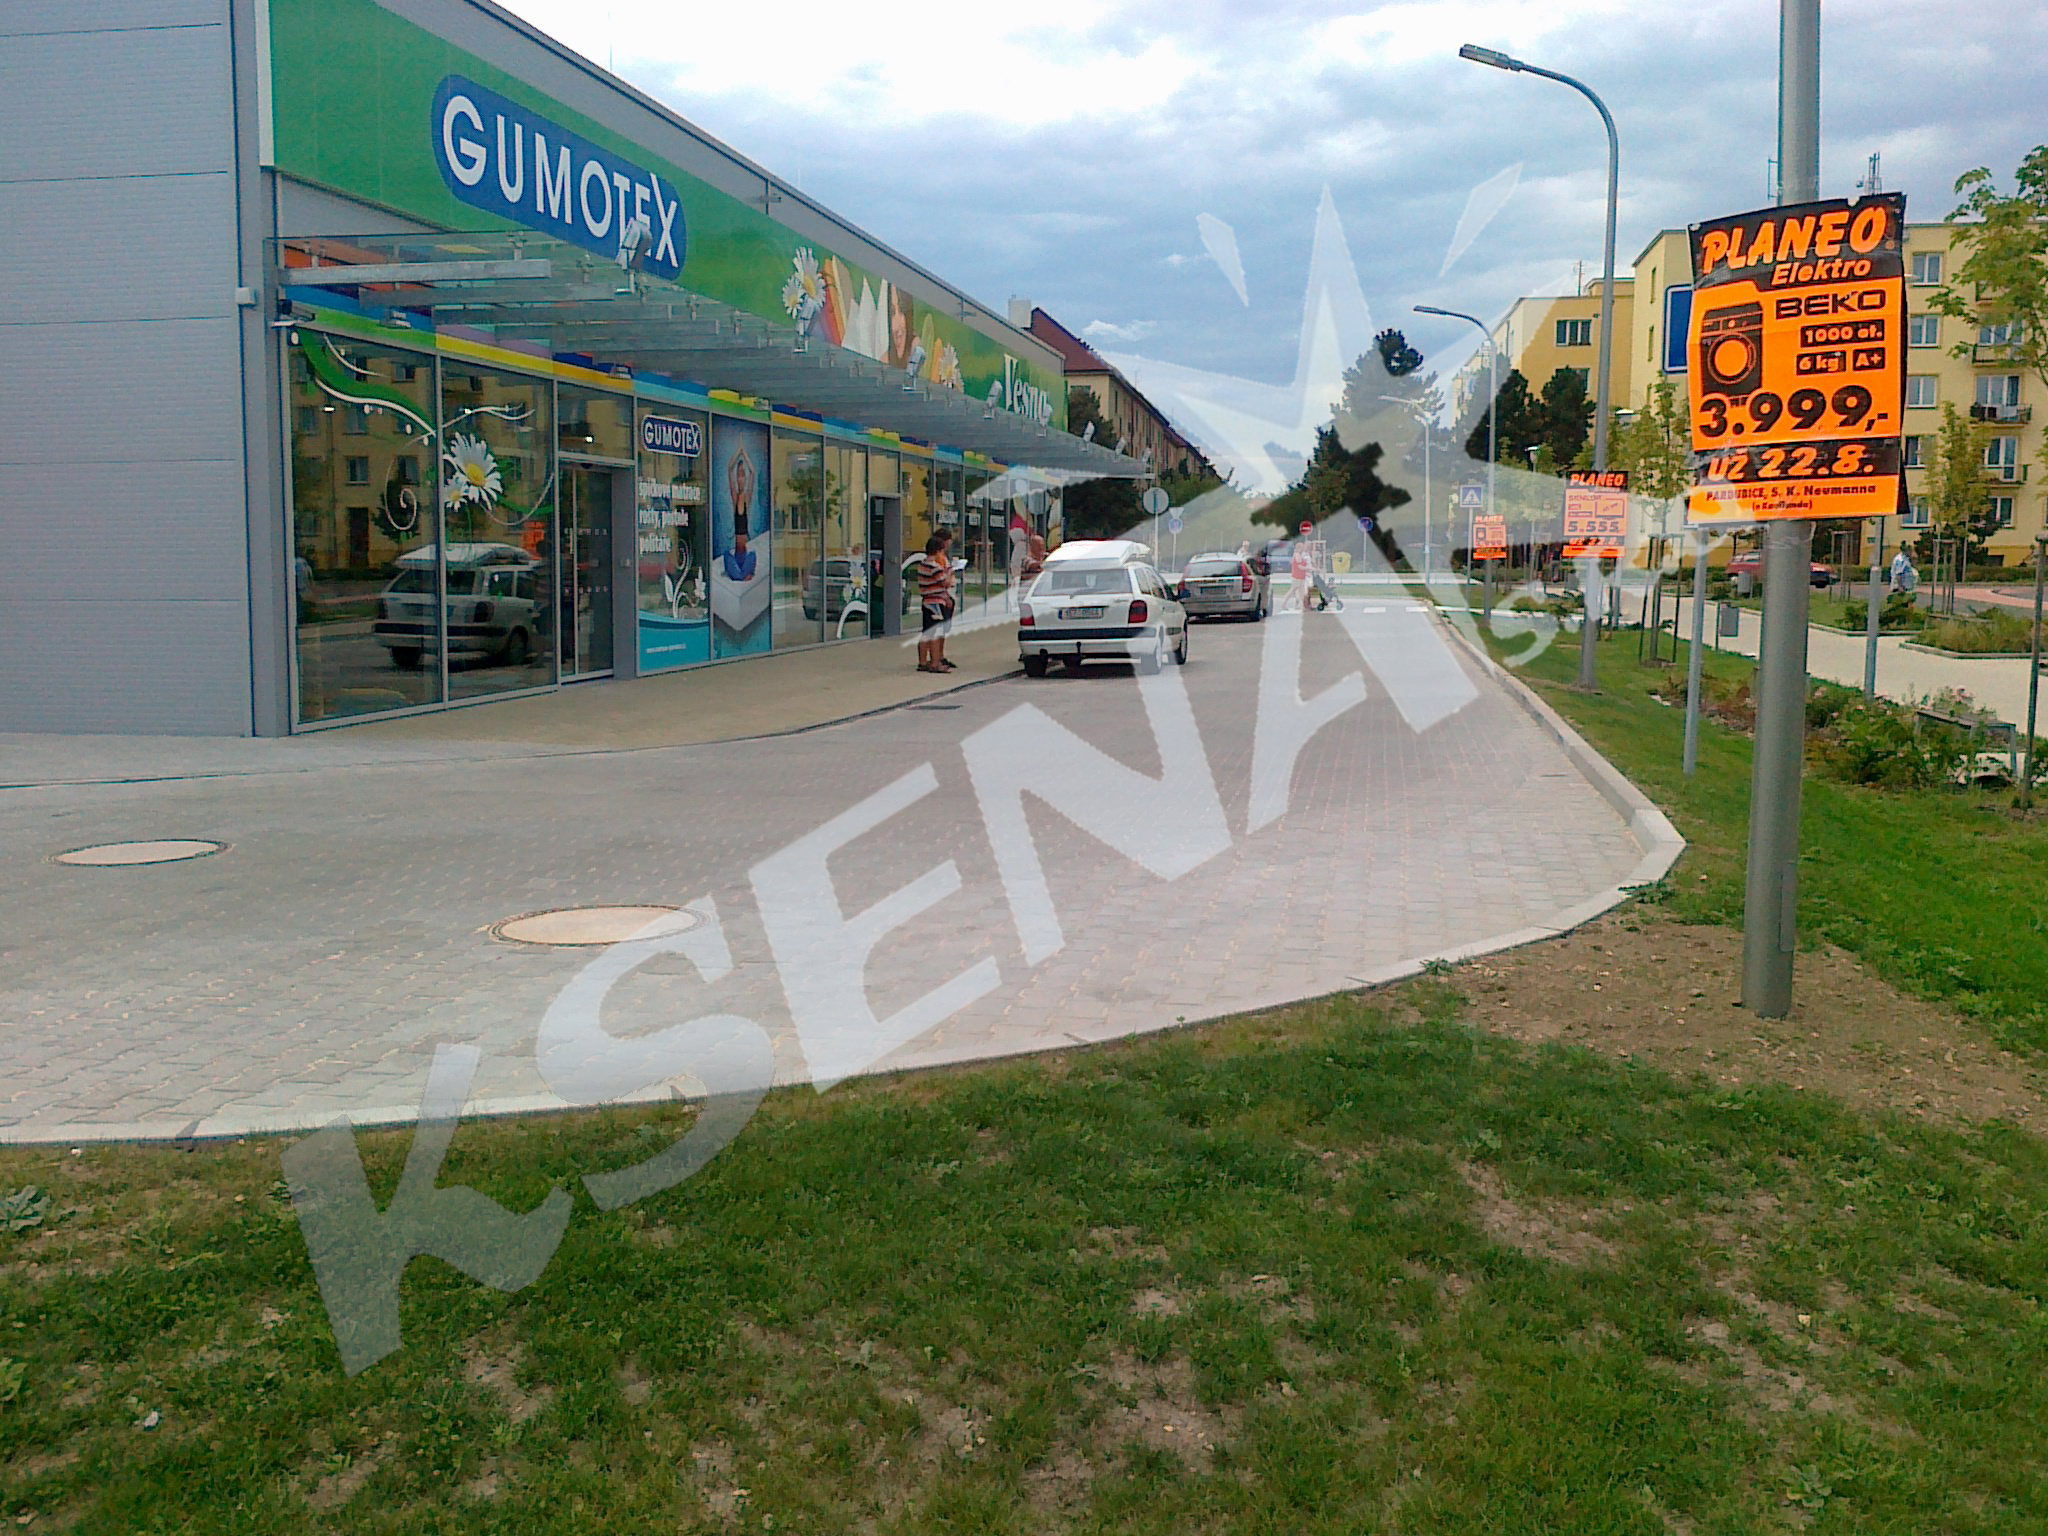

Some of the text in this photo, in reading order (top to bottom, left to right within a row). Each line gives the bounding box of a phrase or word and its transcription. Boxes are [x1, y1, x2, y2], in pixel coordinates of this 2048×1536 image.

[443, 95, 679, 268] GUMOTEX
[1701, 206, 1887, 275] PLANEO
[1771, 258, 1872, 287] Elektro
[1775, 289, 1886, 320] BEKO
[1805, 325, 1854, 344] 1000
[1799, 352, 1882, 372] 6 kg A+
[644, 421, 699, 454] GUMOTEX
[1757, 443, 1874, 479] 22.8.
[1569, 473, 1625, 487] PLANEO
